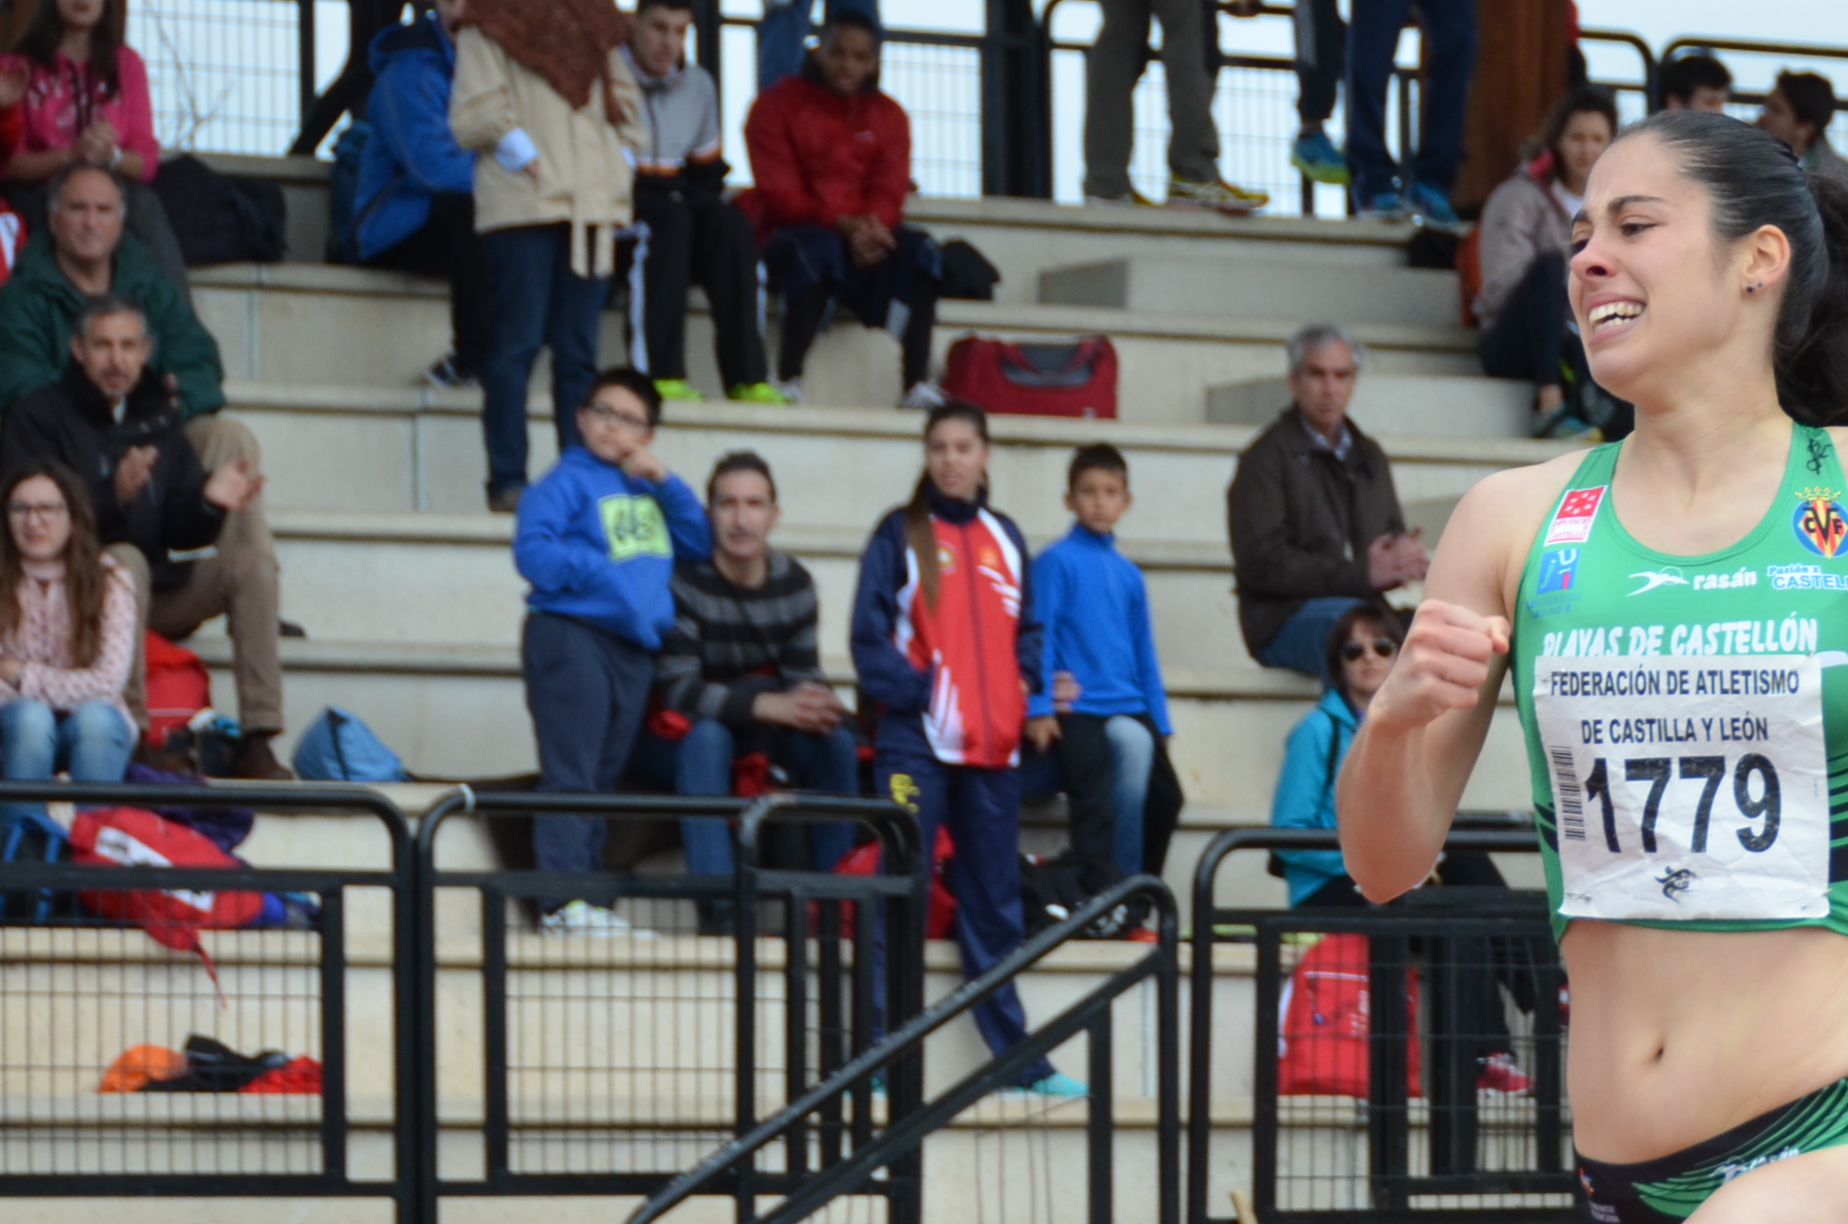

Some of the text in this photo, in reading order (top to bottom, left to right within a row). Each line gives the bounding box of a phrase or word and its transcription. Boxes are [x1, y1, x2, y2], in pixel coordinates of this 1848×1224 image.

[1693, 567, 1758, 590] rasán
[1628, 625, 1664, 656] DE
[1670, 611, 1818, 656] CASTELLÓN
[1551, 664, 1799, 696] FEDERACIÓN DE ATLETISMO
[1581, 711, 1769, 744] DE CASTILLA Y LEÓN
[1585, 753, 1781, 853] 1779
